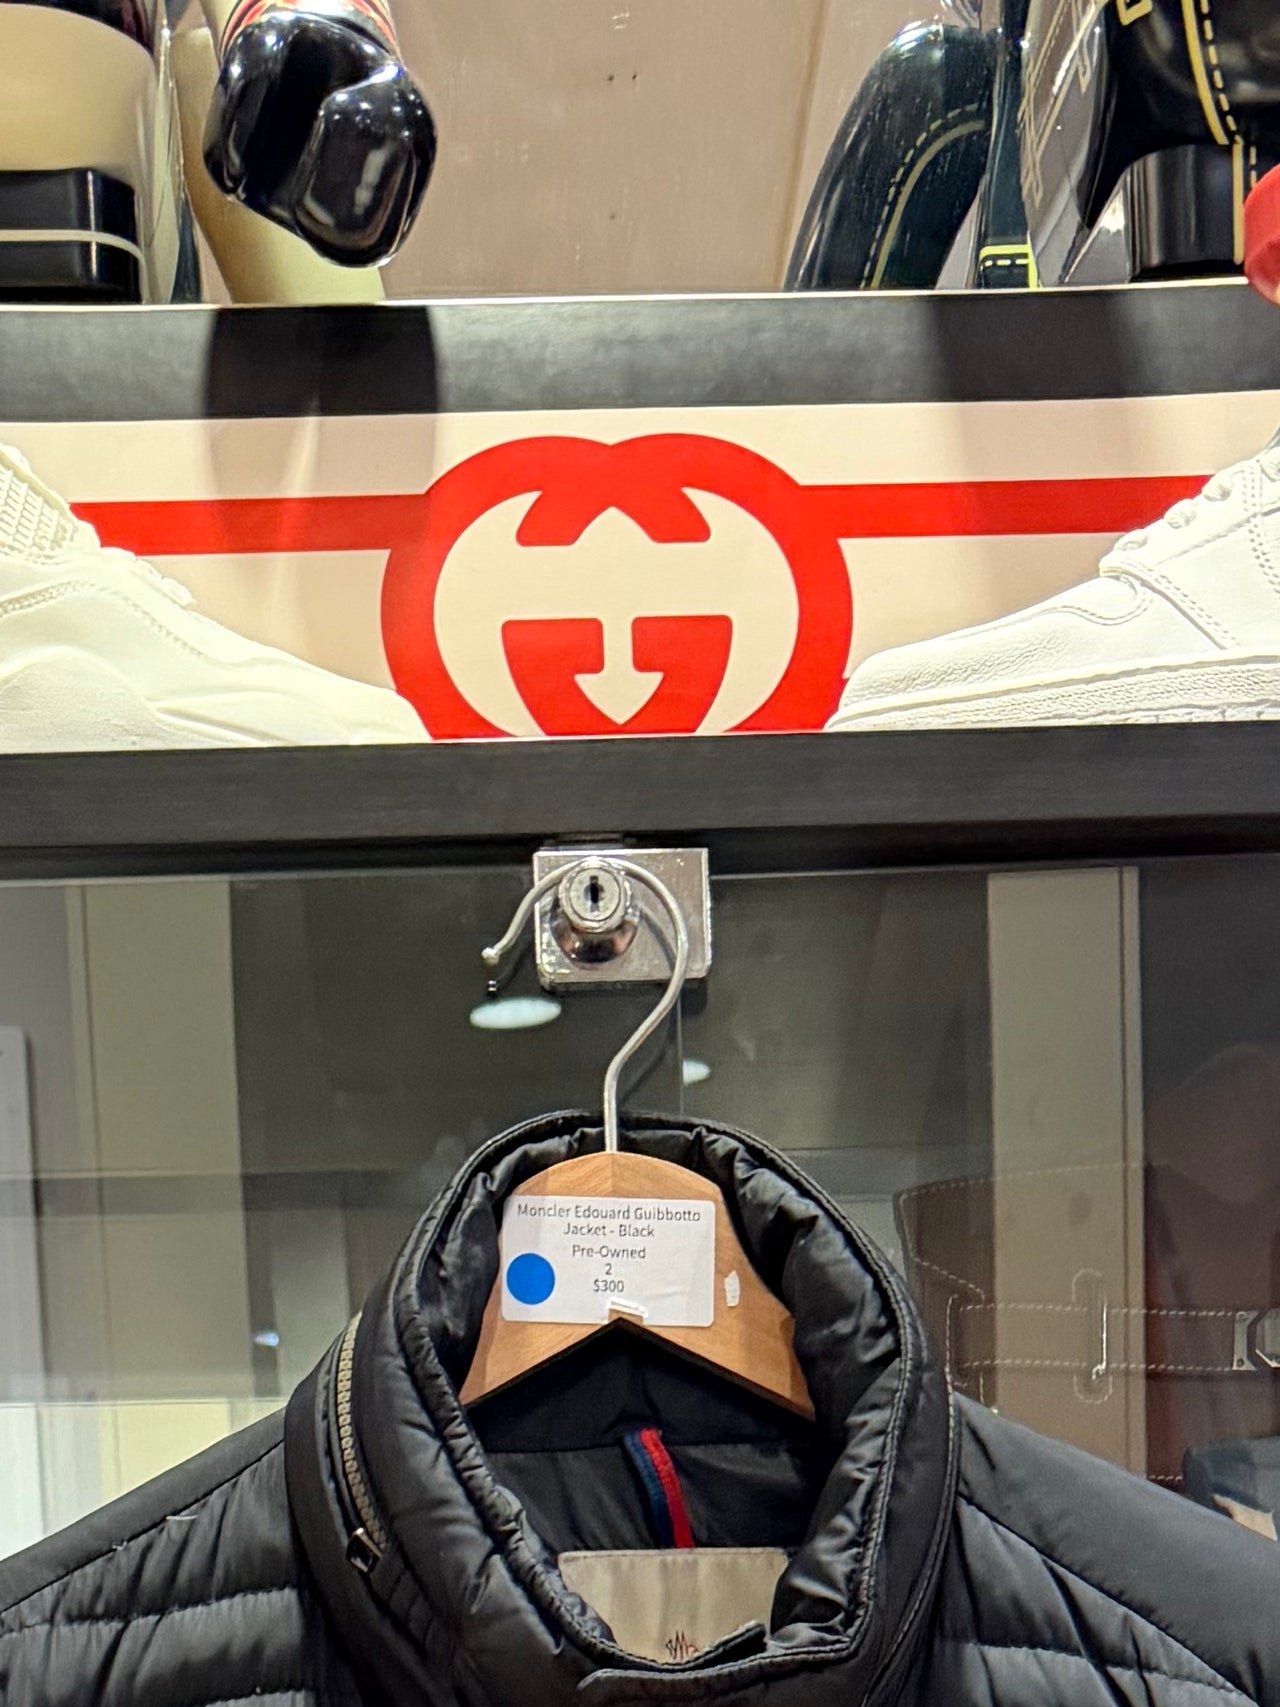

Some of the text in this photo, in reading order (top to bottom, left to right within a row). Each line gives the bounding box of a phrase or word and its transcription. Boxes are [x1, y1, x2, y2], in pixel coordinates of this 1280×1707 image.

[517, 1203, 571, 1218] Moncler
[575, 1205, 630, 1220] Edouard
[563, 1223, 607, 1237] Jacket
[619, 1224, 655, 1238] Black
[572, 1244, 647, 1260] Pre-Owned
[604, 1262, 613, 1276] 2
[592, 1278, 625, 1293] $300
